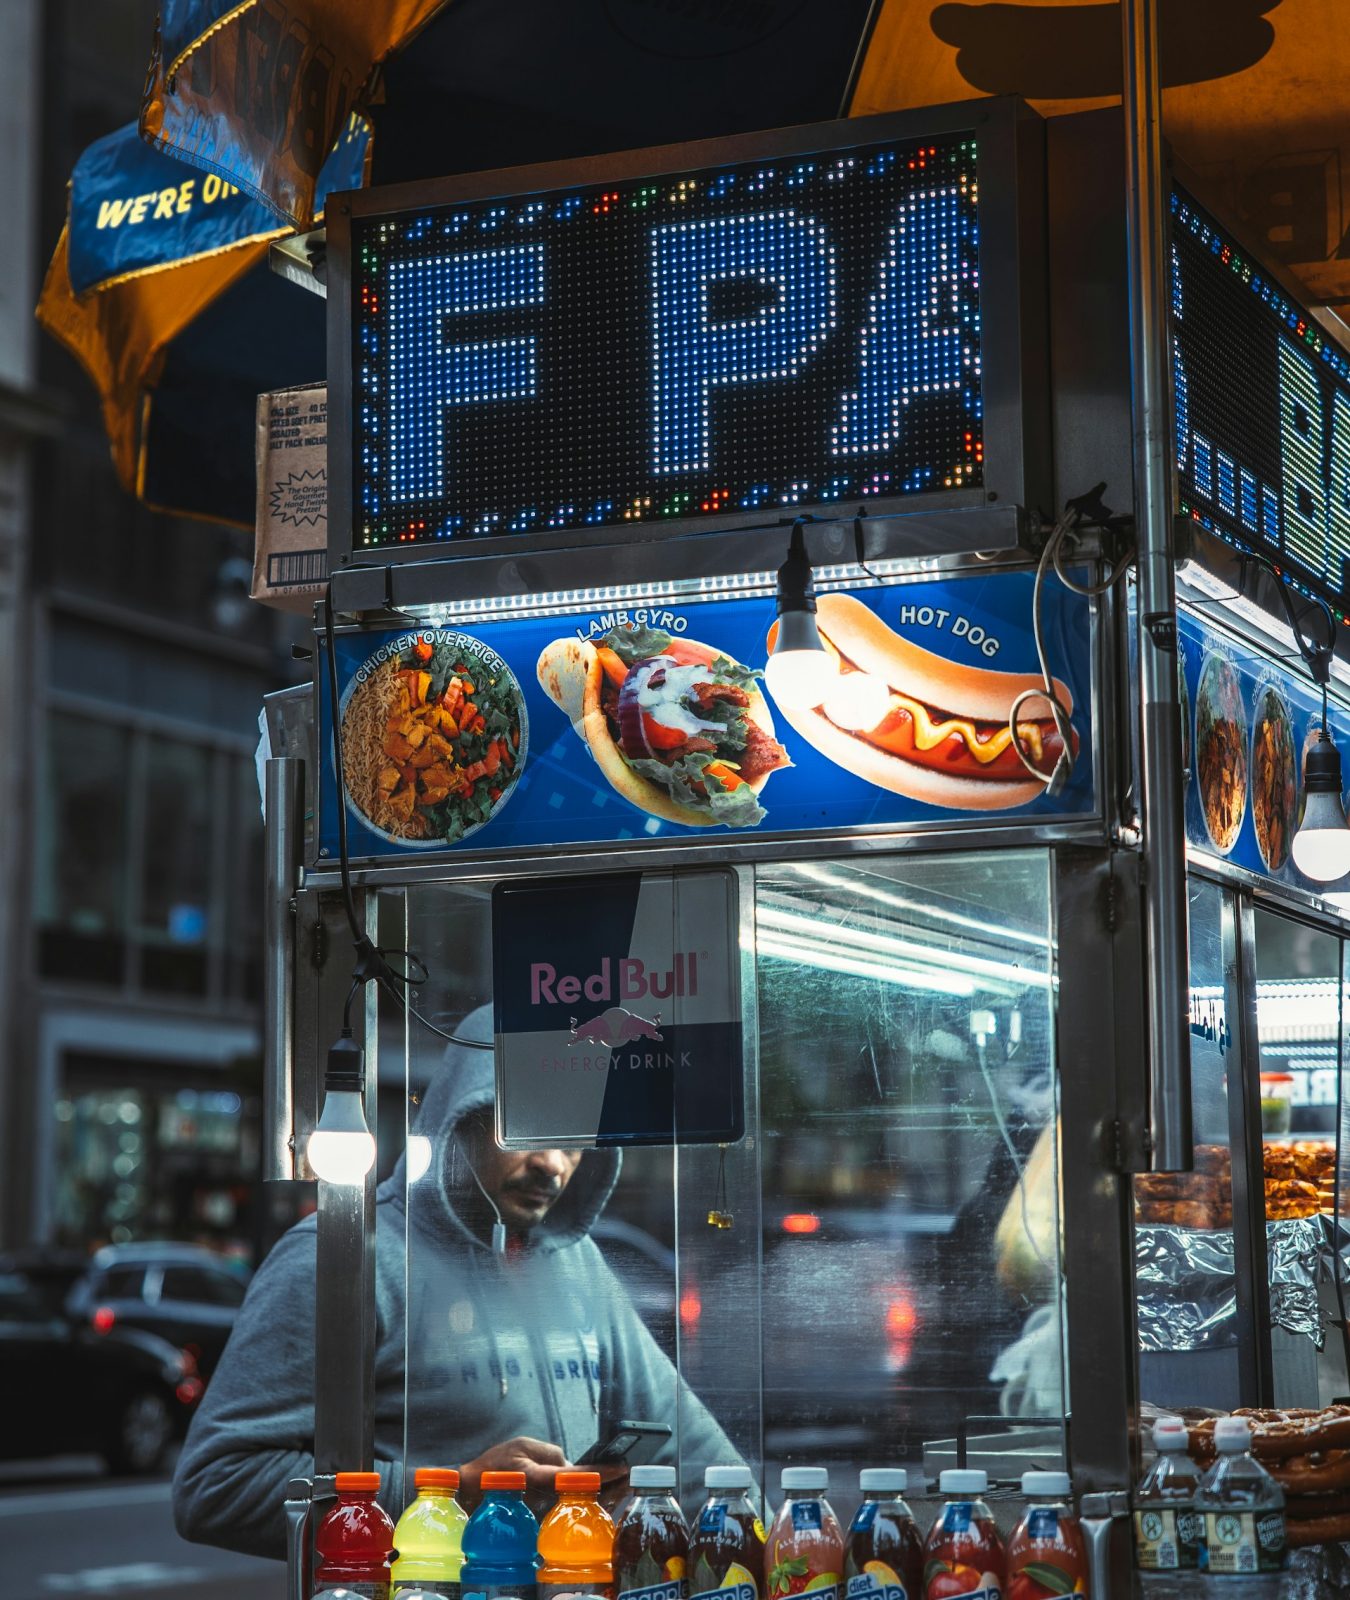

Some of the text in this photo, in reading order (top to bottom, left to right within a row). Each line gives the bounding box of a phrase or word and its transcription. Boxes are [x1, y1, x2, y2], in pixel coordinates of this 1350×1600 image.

[96, 179, 195, 230] WE'RE
[389, 241, 544, 502] F
[309, 414, 327, 424] PRET
[576, 608, 688, 642] LAMB GYRO
[900, 605, 1000, 657] HOT DOG
[355, 631, 504, 683] CHICKEN OVER RICE
[530, 951, 699, 1005] Red Bull
[541, 1051, 693, 1073] ENERGY DRINK
[849, 1577, 874, 1595] diet
